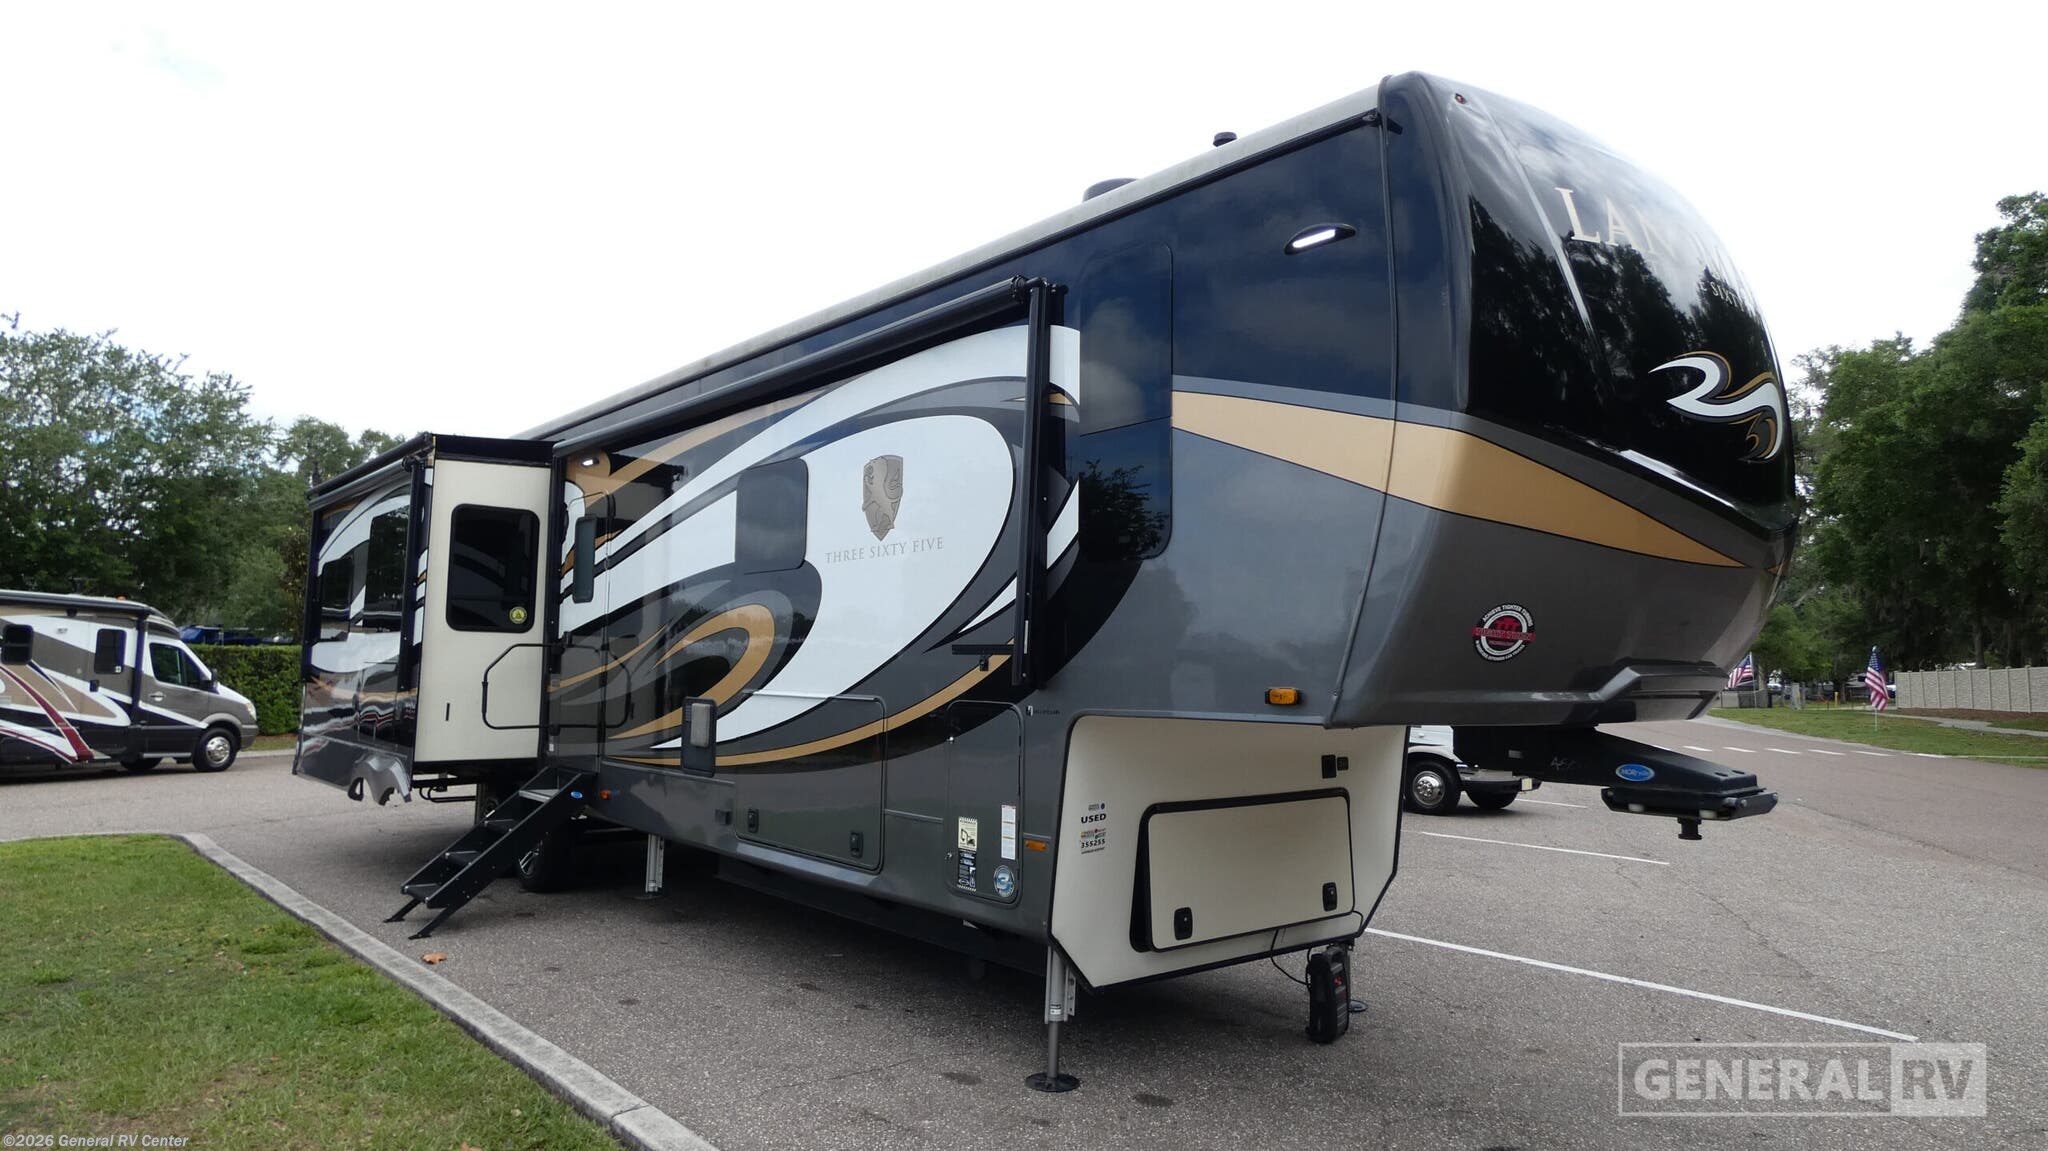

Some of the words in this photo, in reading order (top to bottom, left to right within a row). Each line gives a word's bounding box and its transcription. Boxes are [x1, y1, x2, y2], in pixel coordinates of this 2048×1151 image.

[824, 547, 865, 564] THREE
[869, 542, 907, 559] SIXTY
[912, 536, 944, 553] FIVE
[1081, 813, 1106, 824] USED
